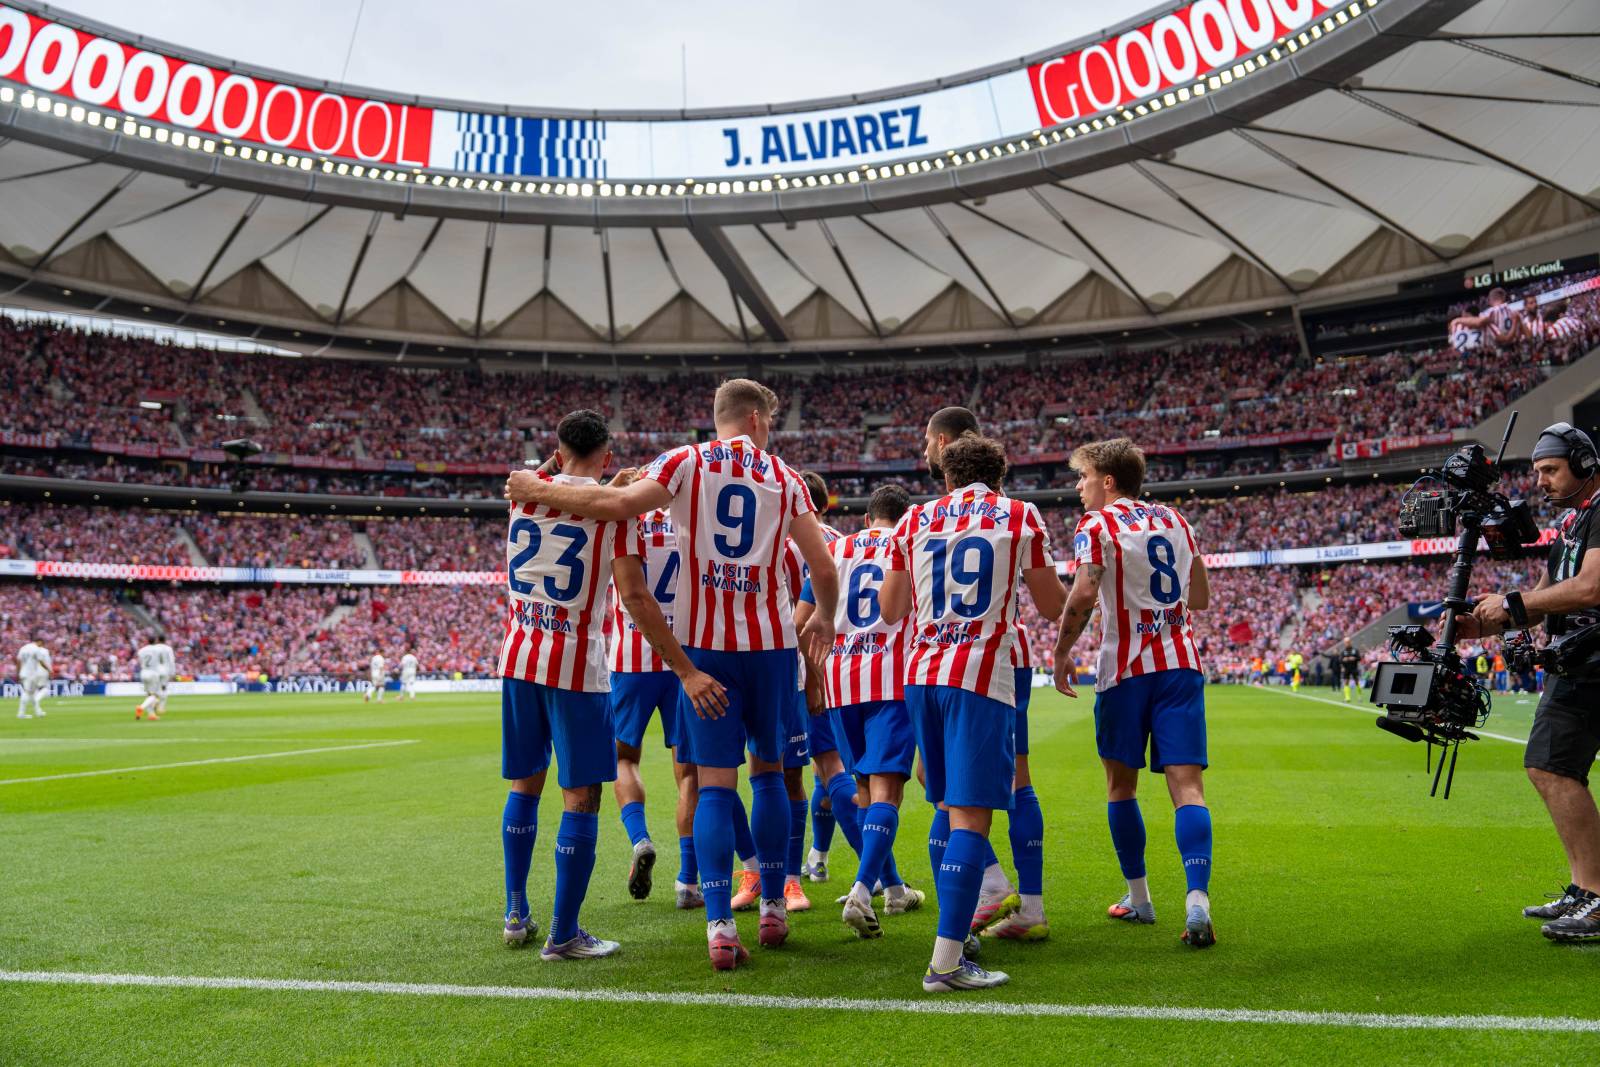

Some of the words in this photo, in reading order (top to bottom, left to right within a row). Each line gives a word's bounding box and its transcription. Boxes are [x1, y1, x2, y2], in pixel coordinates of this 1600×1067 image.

[723, 129, 752, 168] J.
[761, 105, 929, 165] ALVAREZ
[1474, 273, 1492, 288] LG
[714, 484, 756, 558] 9
[937, 501, 1010, 525] ALVAREZ
[509, 518, 588, 602] 23
[712, 563, 751, 578] VISIT
[923, 536, 994, 619] 19
[1147, 535, 1181, 604] 8
[847, 564, 884, 628] 6
[523, 601, 558, 617] VISIT
[845, 632, 879, 644] VISIT
[277, 680, 340, 693] RIYADH
[506, 824, 535, 834] ATLETI
[863, 823, 890, 835] ATLETI
[702, 879, 729, 889] ATLETI
